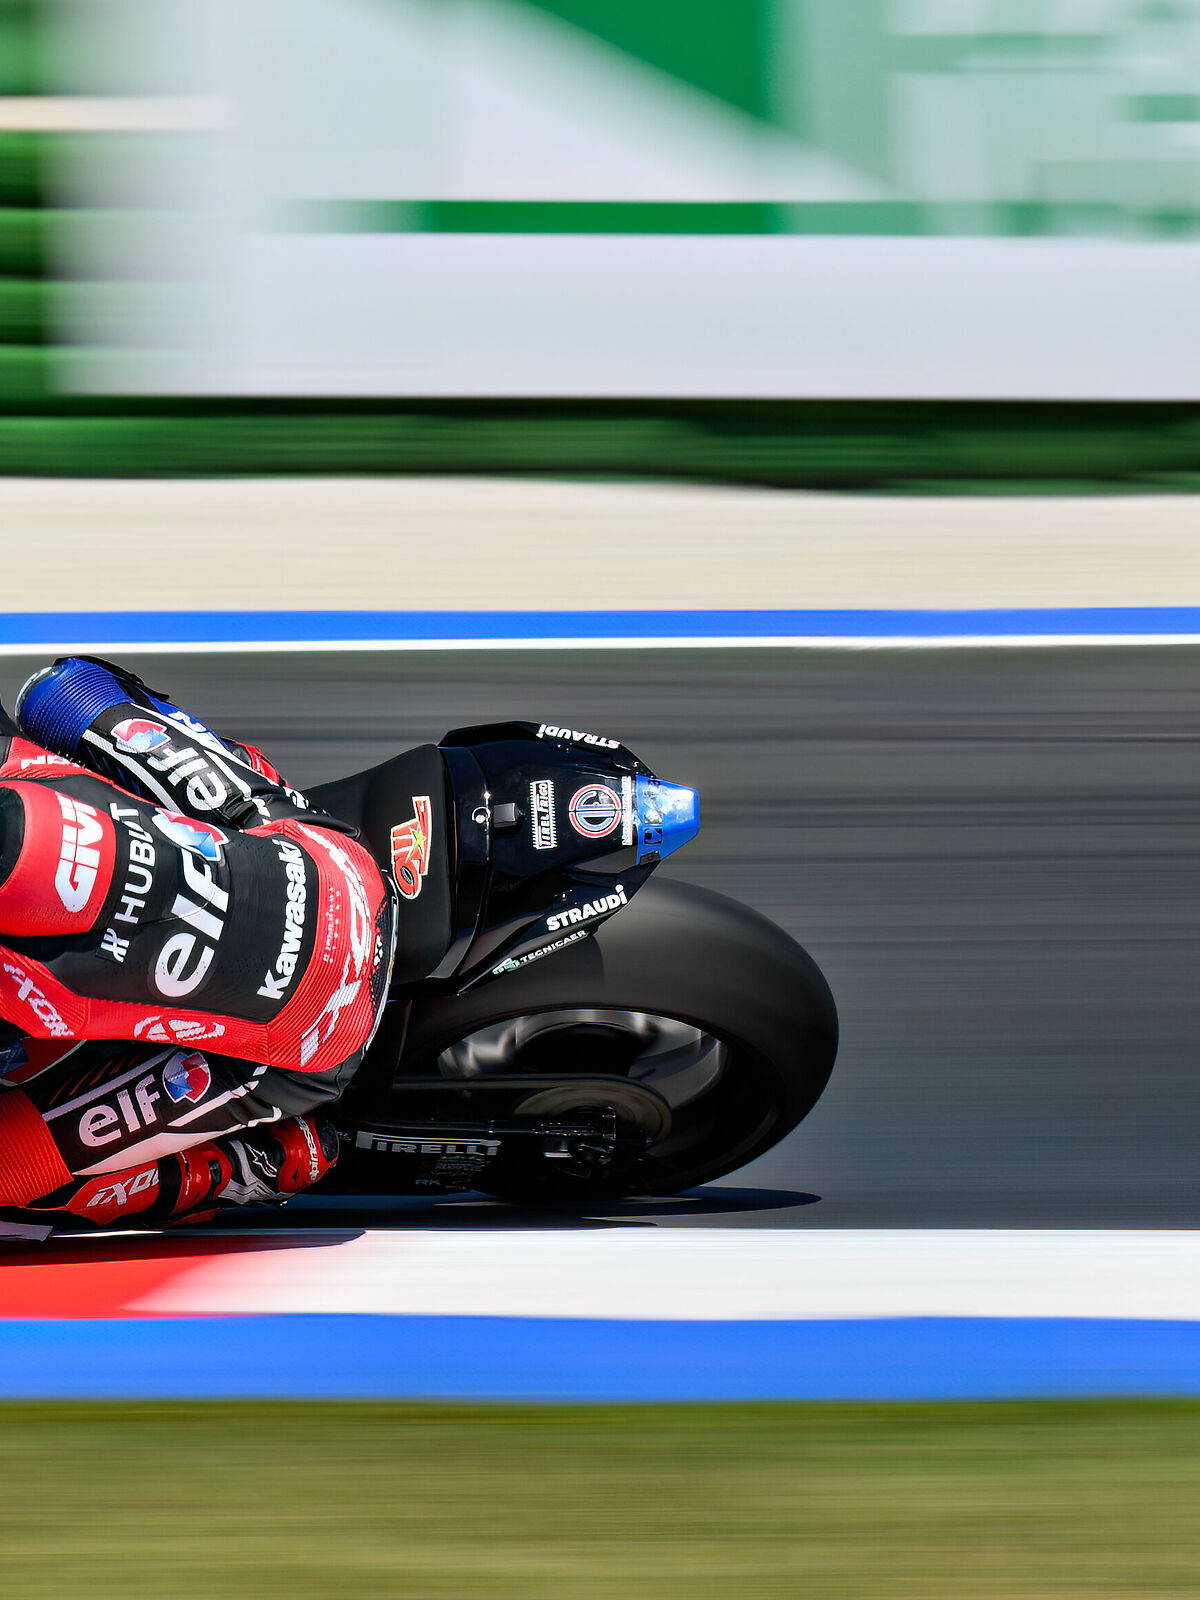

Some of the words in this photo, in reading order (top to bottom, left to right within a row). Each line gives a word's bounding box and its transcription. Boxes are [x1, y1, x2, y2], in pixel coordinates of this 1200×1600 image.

[147, 745, 230, 811] elf
[154, 848, 230, 998] elf
[257, 838, 306, 999] Kawasaki
[519, 930, 588, 964] TECNICAER
[79, 1074, 161, 1147] elf
[355, 1130, 502, 1156] PIRELLI
